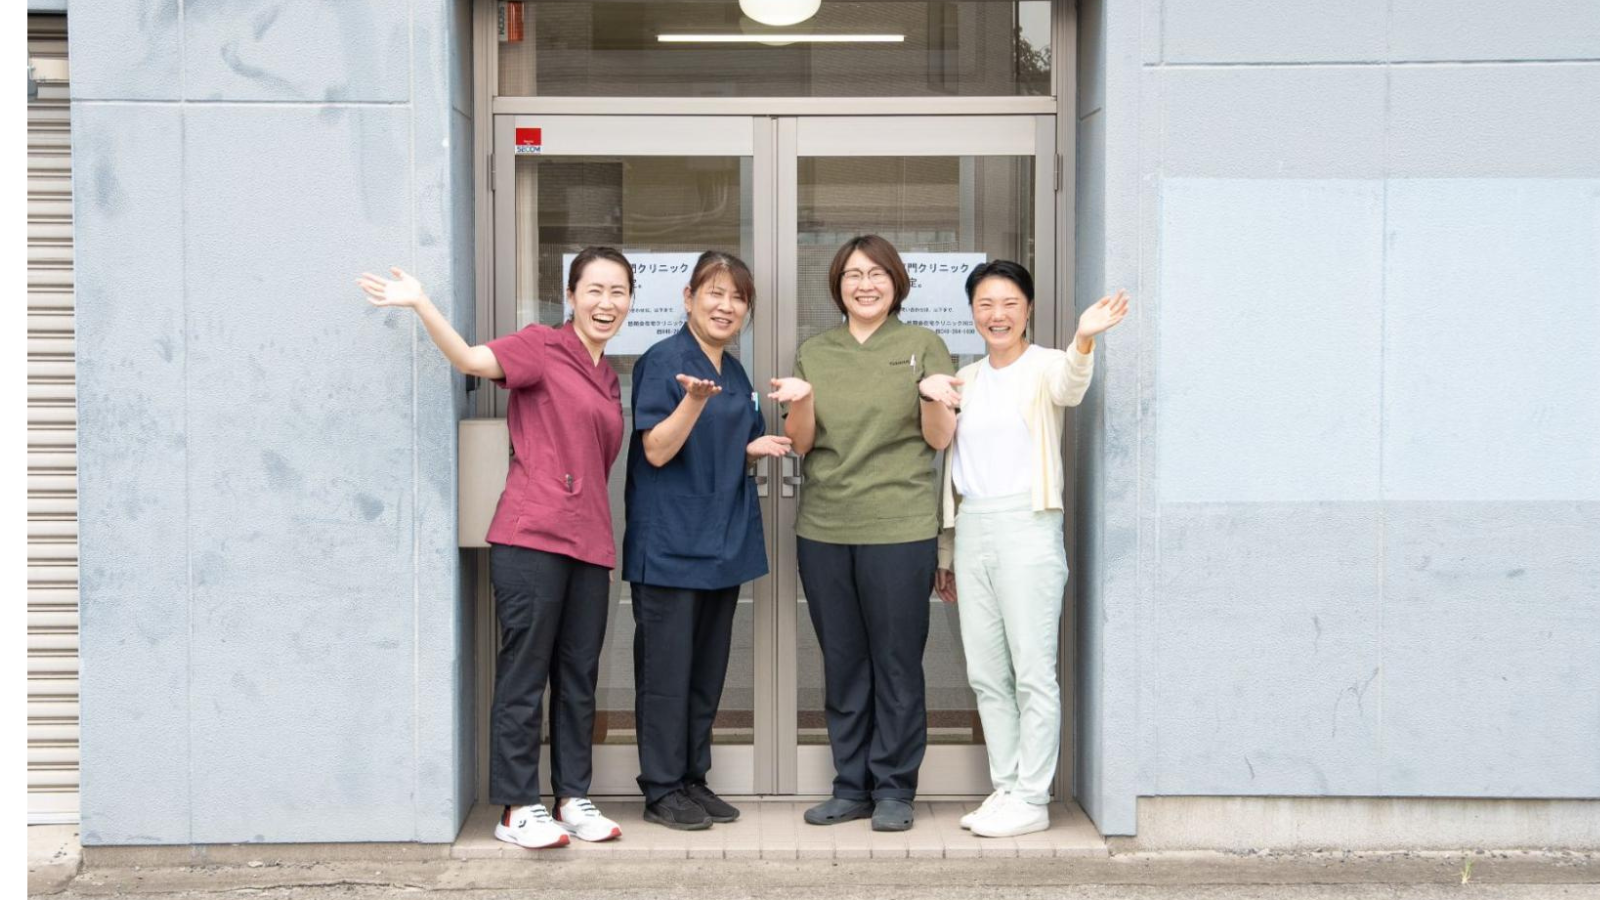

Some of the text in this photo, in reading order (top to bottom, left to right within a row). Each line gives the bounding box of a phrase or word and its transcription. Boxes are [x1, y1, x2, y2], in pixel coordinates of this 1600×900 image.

[903, 262, 969, 274] 門クリニック
